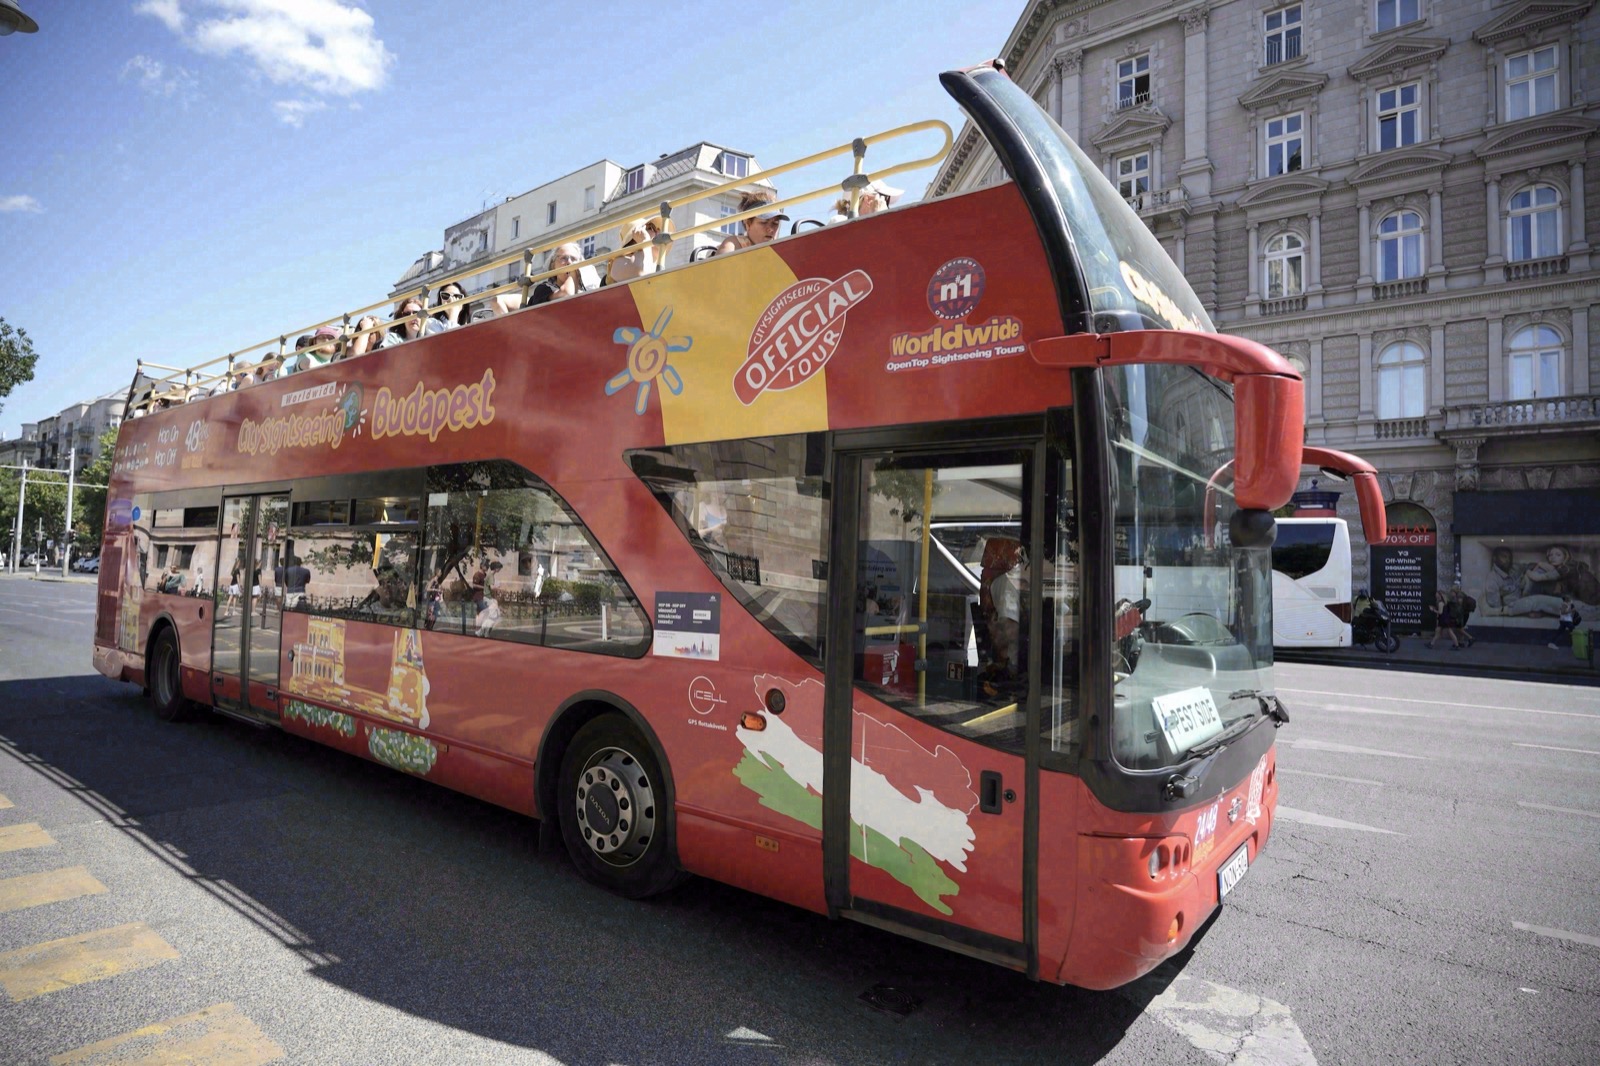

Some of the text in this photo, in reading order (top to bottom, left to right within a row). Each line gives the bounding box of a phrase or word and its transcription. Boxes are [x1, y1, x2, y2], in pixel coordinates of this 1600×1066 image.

[937, 260, 976, 275] Operador
[753, 282, 820, 345] CITYSIGHTSEEING
[935, 305, 973, 320] Operator
[746, 281, 864, 389] OFFICIAL
[892, 318, 1020, 356] Worldwide
[787, 330, 840, 382] TOUR
[931, 349, 992, 365] Sightseeing
[994, 345, 1025, 355] Tours
[285, 384, 335, 405] Worldwide
[371, 367, 496, 443] Budapest
[1386, 535, 1430, 543] 70% OFF
[1193, 698, 1216, 726] SIDE
